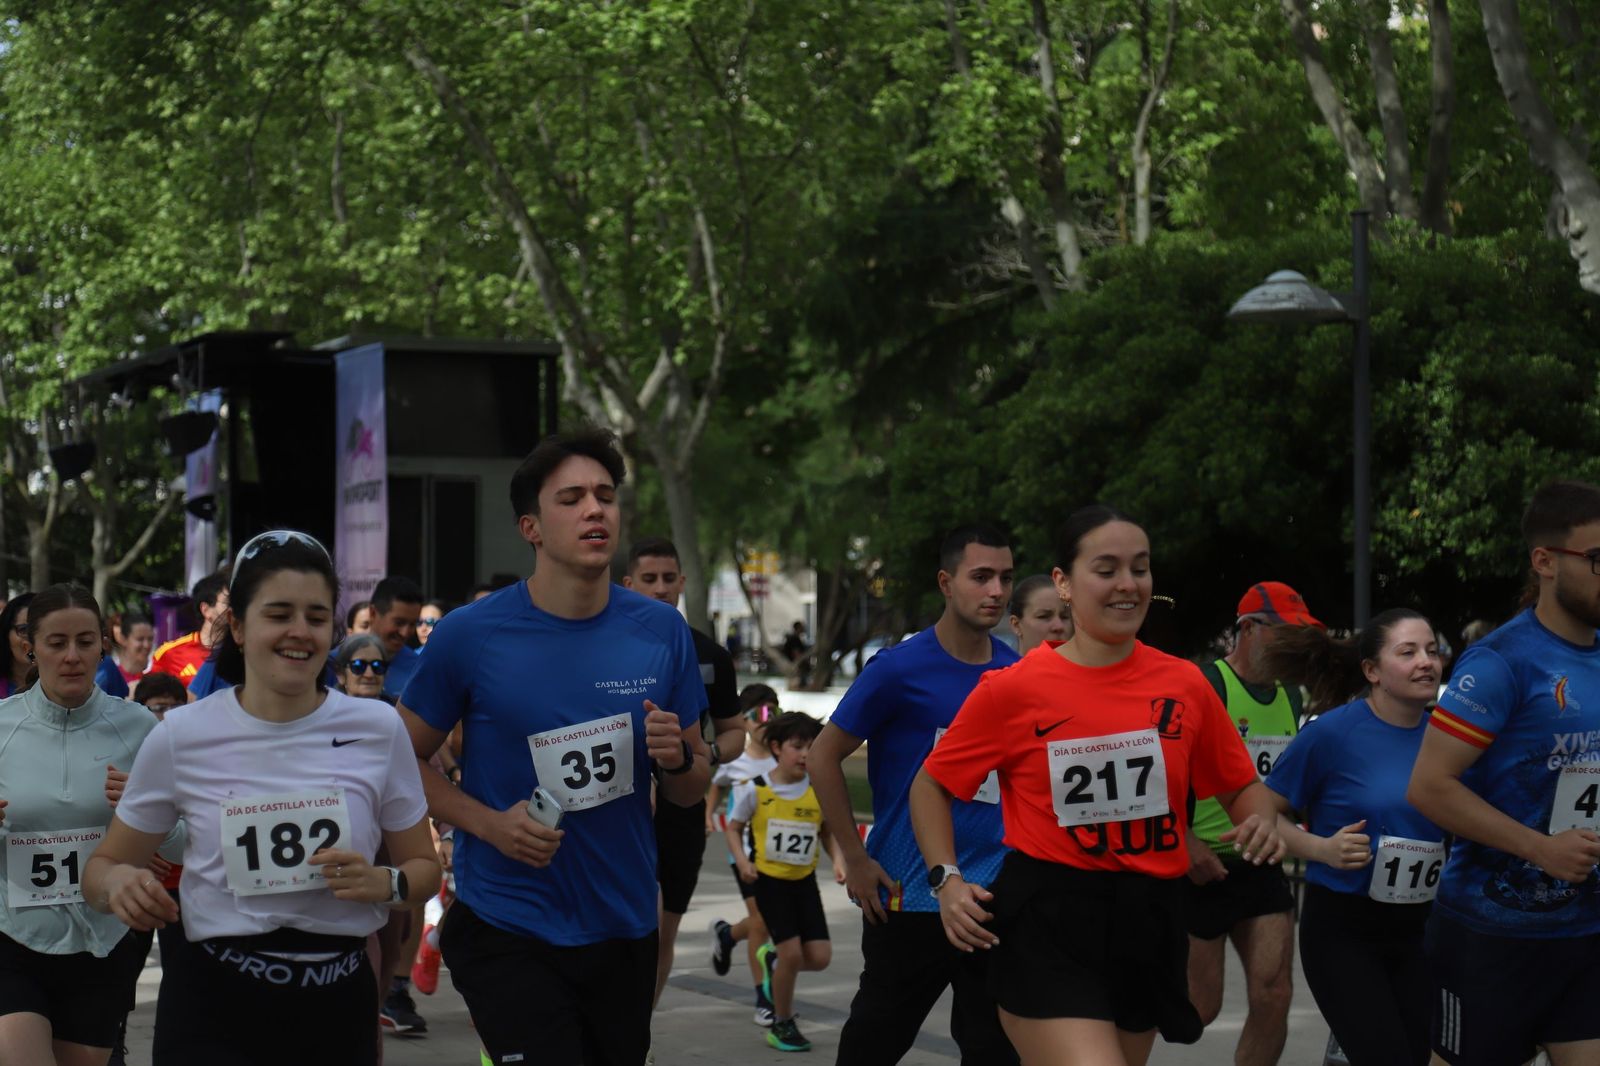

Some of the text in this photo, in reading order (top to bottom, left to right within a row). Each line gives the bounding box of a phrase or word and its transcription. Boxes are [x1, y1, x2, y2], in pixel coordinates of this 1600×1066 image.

[595, 680, 631, 688] CASTILLA
[640, 676, 657, 685] LEÓN
[535, 720, 628, 749] DÍA DE CASTILLA Y LEÓN
[1054, 736, 1155, 757] DÍA DE CASTILLA Y LEÓN
[561, 742, 616, 790] 35
[1257, 751, 1284, 776] 6
[1063, 755, 1154, 805] 217
[226, 797, 340, 817] DÍA DE CASTILLA Y LEÓN
[1574, 783, 1599, 818] 4
[11, 838, 25, 846] DÍA
[37, 835, 73, 845] CASTILLA
[81, 832, 101, 841] LEÓN
[236, 818, 340, 872] 182
[773, 832, 814, 855] 127
[1407, 845, 1435, 854] CASTILLA
[30, 850, 79, 888] 51
[1384, 856, 1443, 889] 116
[219, 947, 360, 987] PRO NIKE
